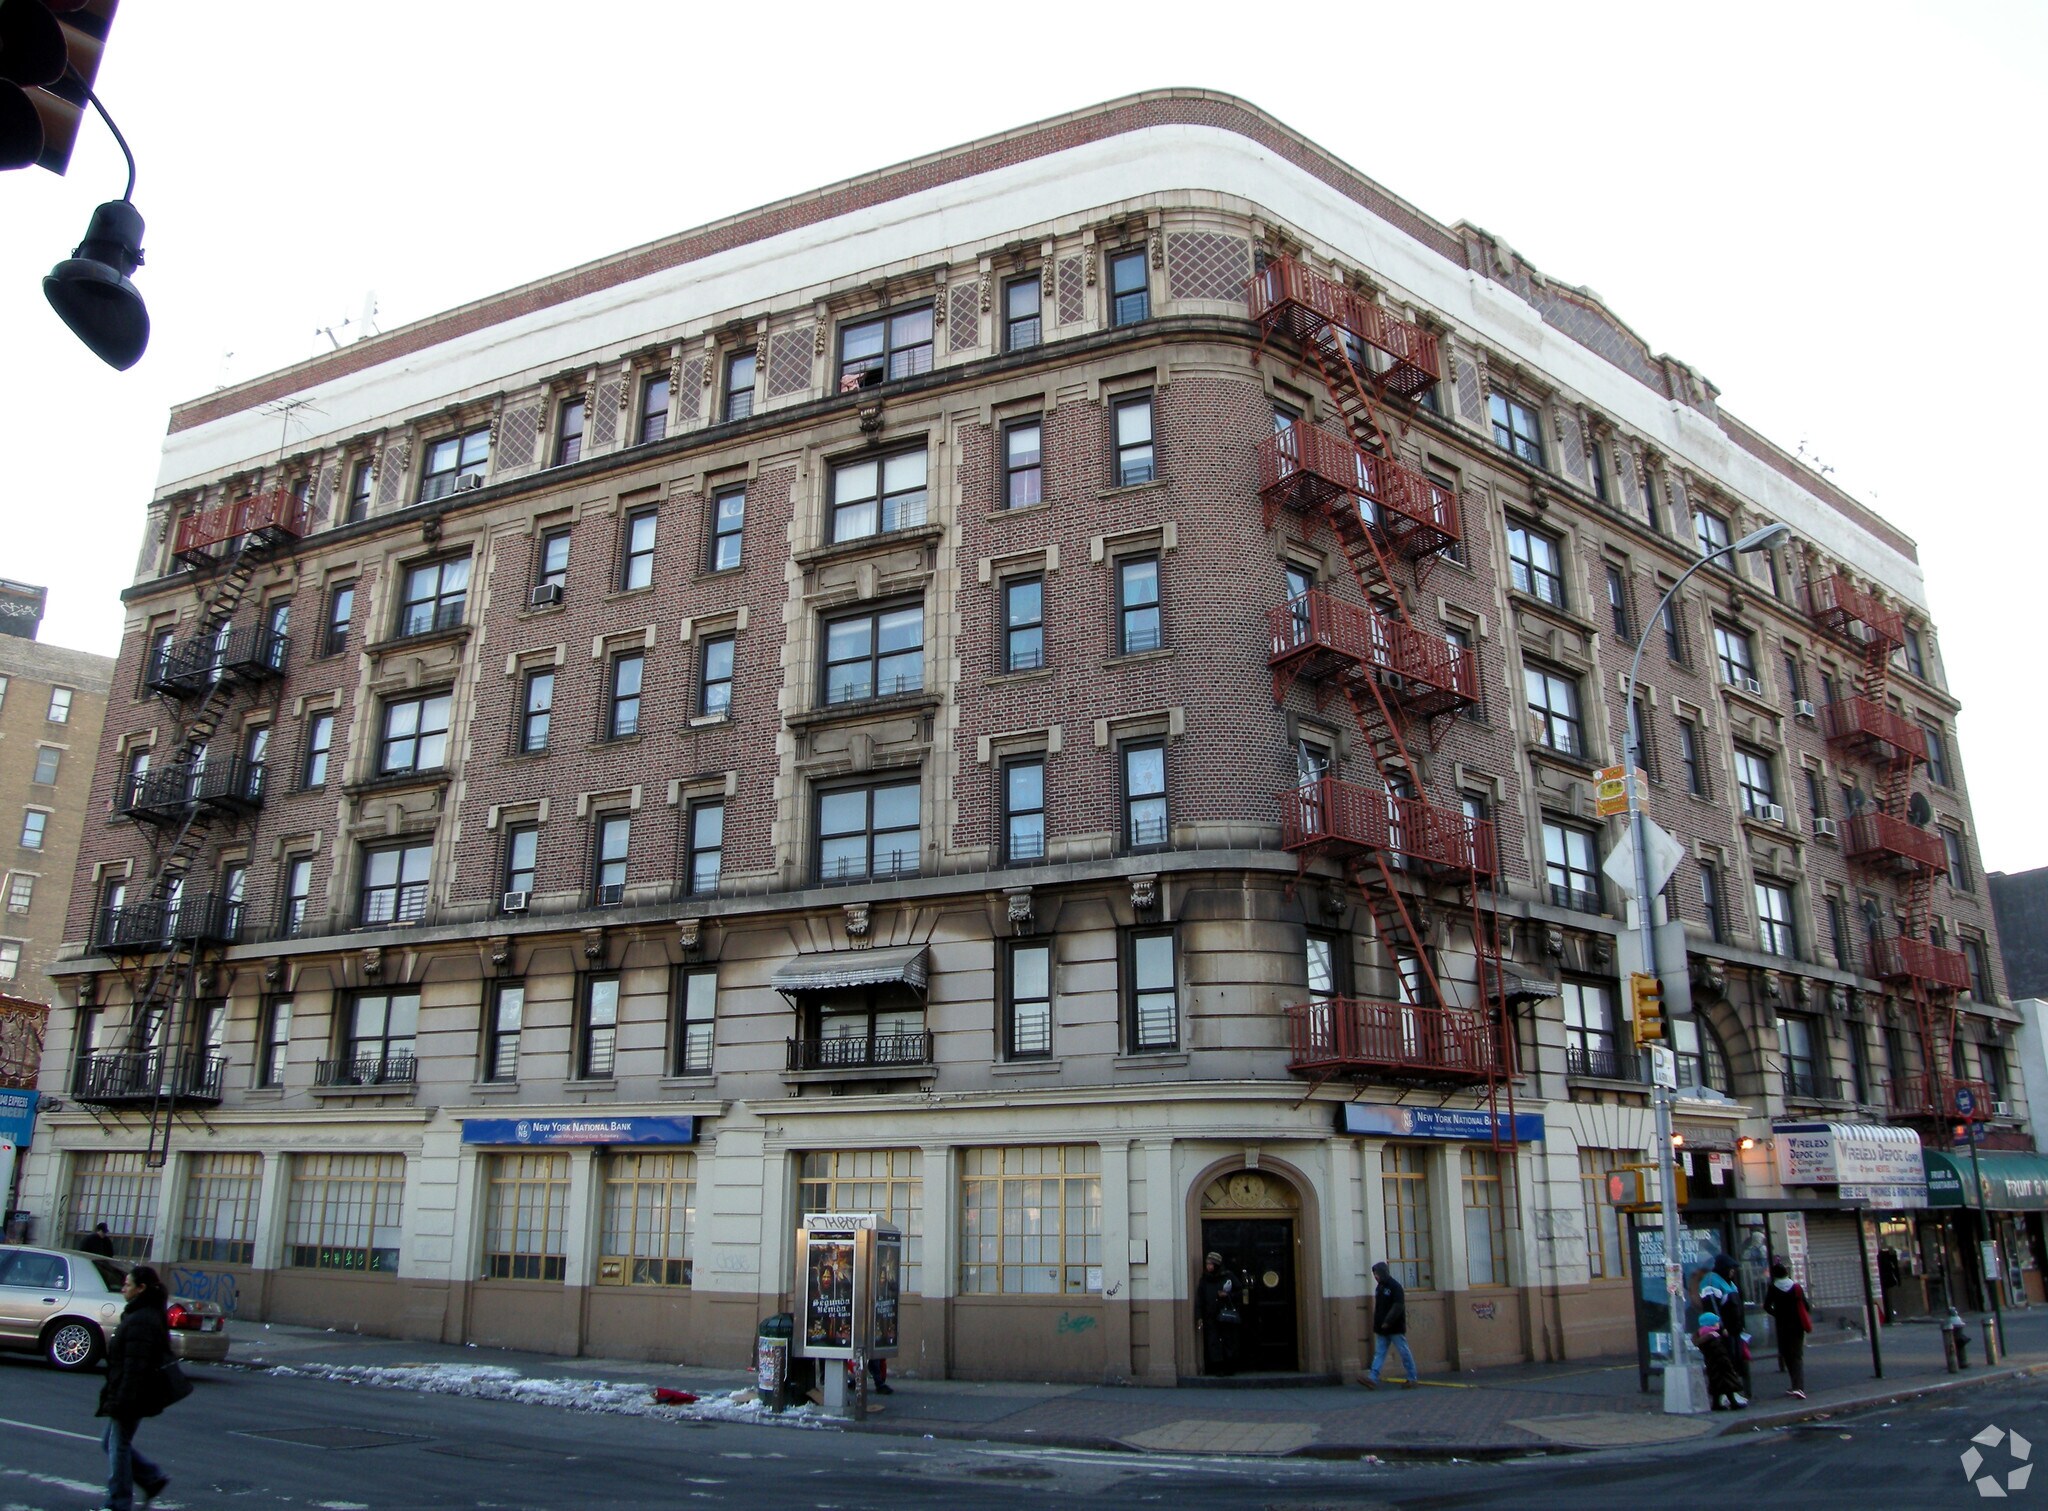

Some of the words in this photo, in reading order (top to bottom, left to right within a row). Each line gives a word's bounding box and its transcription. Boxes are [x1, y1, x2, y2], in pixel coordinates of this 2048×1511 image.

[8, 1096, 28, 1108] EXPRESS
[1417, 1112, 1433, 1122] NEW
[1434, 1113, 1452, 1124] YORK
[1453, 1114, 1483, 1125] NATIONAL
[532, 1122, 550, 1131] NEW
[552, 1122, 570, 1131] YORK
[572, 1122, 609, 1132] NATIONAL
[610, 1122, 632, 1130] BANK
[1790, 1149, 1813, 1159] DEPOT
[1878, 1144, 1904, 1160] DEPOT
[1930, 1170, 1945, 1179] FRUIT
[1840, 1187, 1853, 1197] FREE
[1855, 1186, 1867, 1197] CELL
[1870, 1186, 1891, 1197] PHONES
[1910, 1187, 1926, 1197] TONES
[2004, 1179, 2032, 1198] FRUIT
[2034, 1179, 2042, 1196] &
[1638, 1232, 1653, 1242] NYC
[1654, 1232, 1664, 1241] HA
[1694, 1229, 1711, 1240] AIDS
[1639, 1242, 1662, 1253] CASES
[1684, 1241, 1699, 1251] ANY
[1682, 1253, 1698, 1263] CITY
